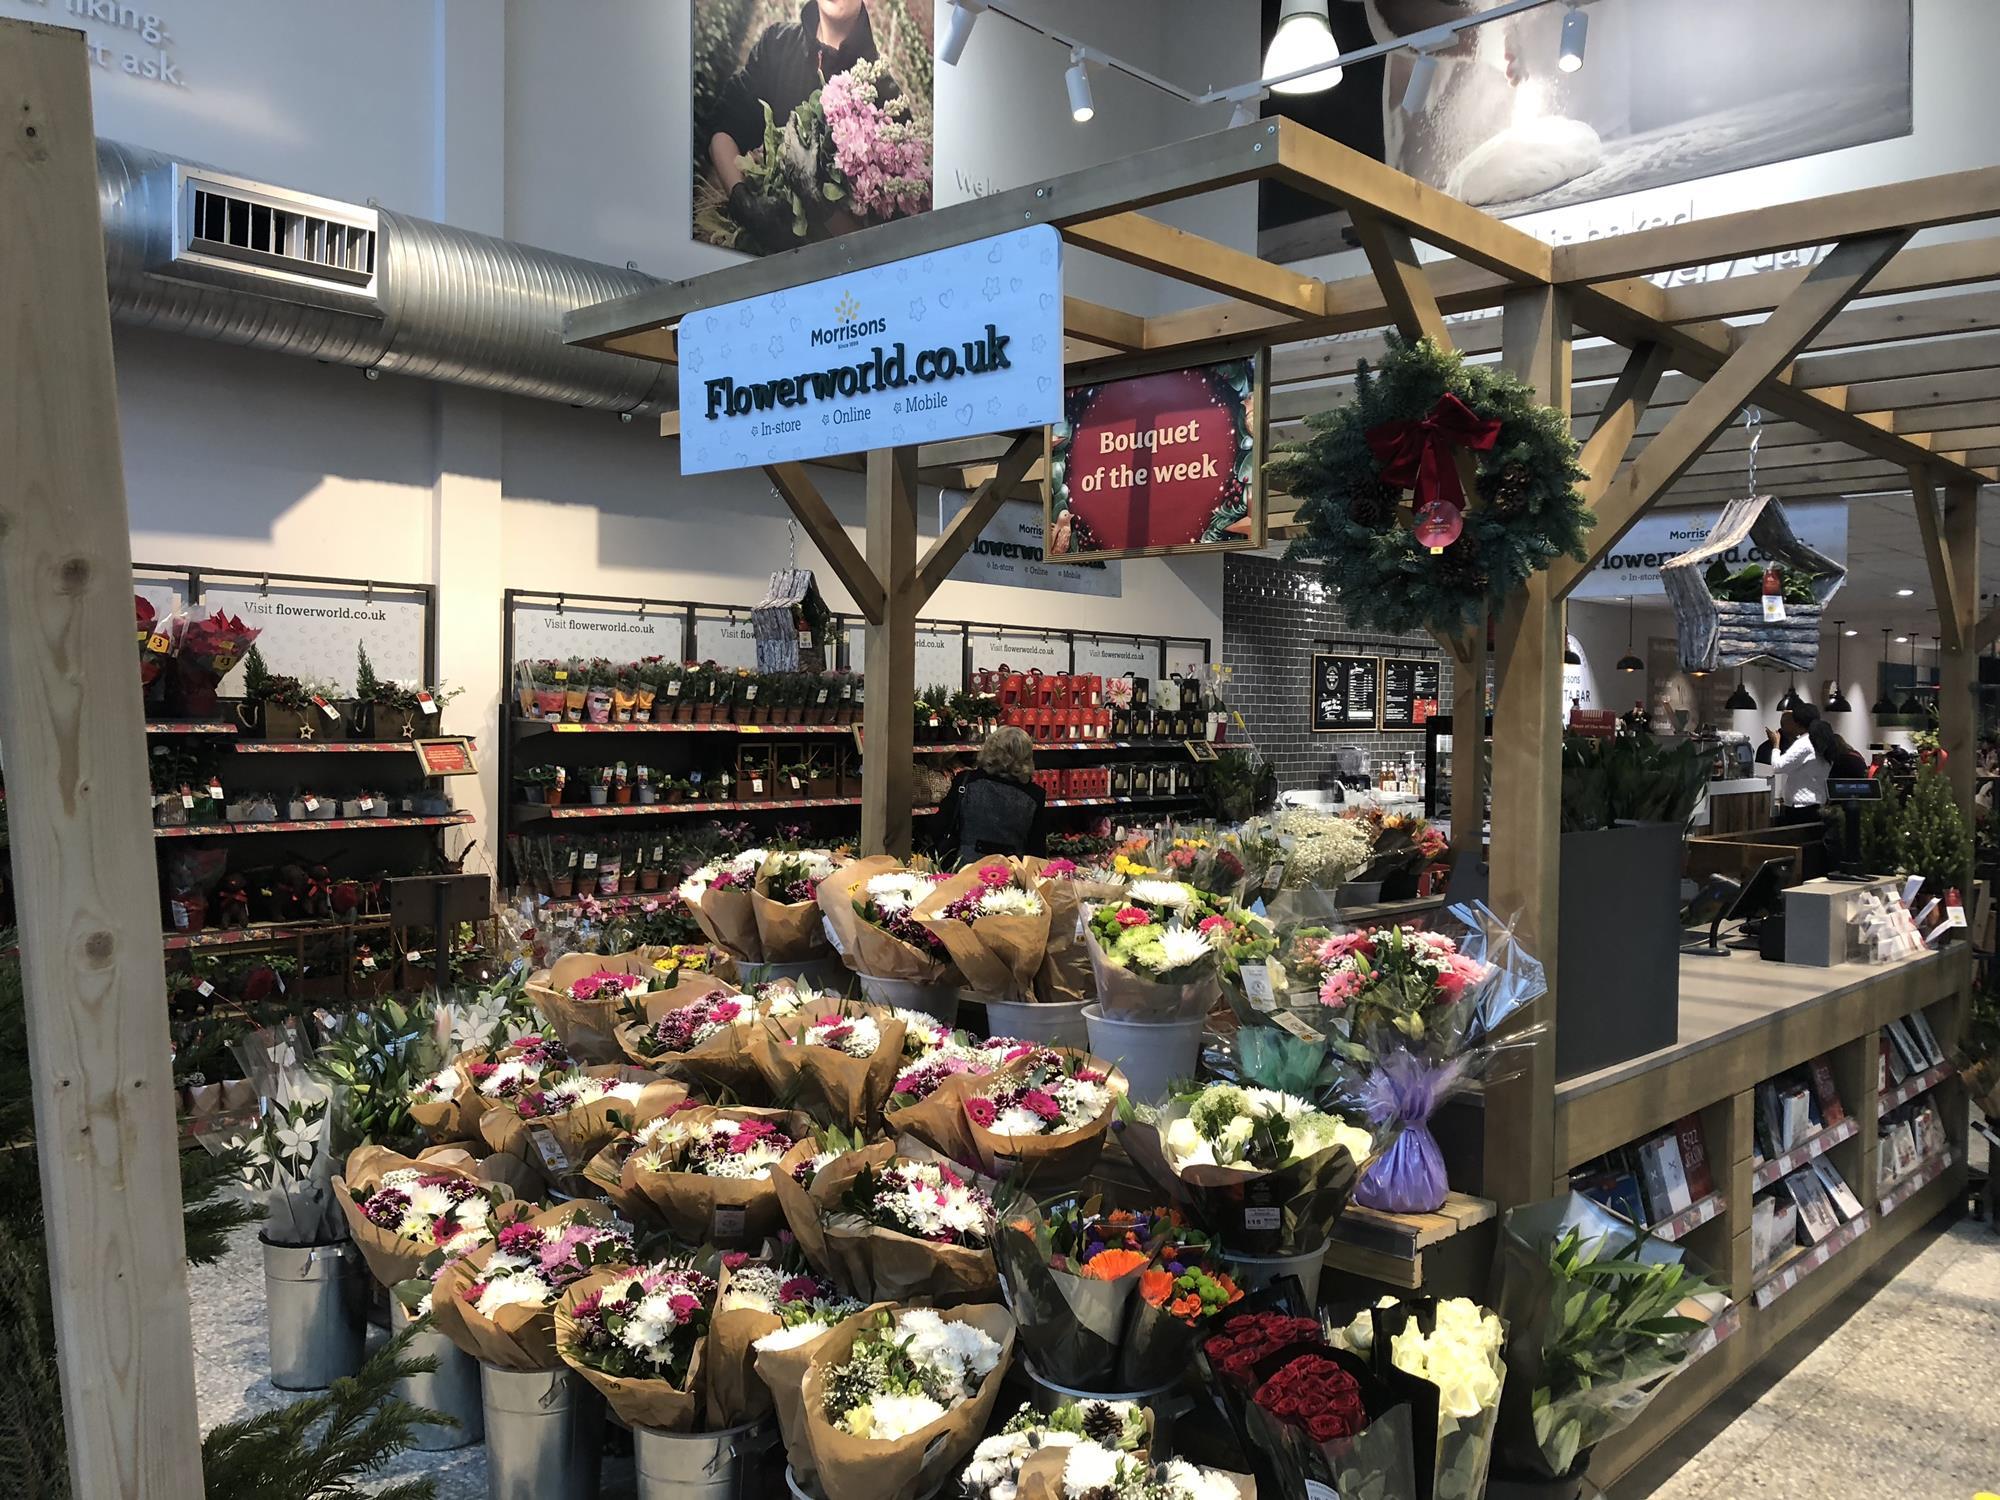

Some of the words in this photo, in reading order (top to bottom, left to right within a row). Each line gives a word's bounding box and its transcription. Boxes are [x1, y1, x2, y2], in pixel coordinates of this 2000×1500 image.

[121, 50, 186, 86] ask.
[811, 317, 887, 347] Morrisons
[704, 324, 1012, 420] Flowerworld.co.uk
[761, 419, 802, 437] In-store
[833, 407, 871, 425] Online
[905, 393, 948, 414] Mobile
[1099, 419, 1201, 454] Bouquet
[1081, 467, 1105, 492] of
[1109, 464, 1148, 490] the
[1153, 453, 1219, 484] week
[1018, 523, 1043, 536] Morris
[1669, 527, 1712, 540] Morriso
[1029, 566, 1049, 576] Online
[244, 601, 273, 615] Visit
[276, 603, 386, 621] flowerworld.co.uk
[544, 618, 567, 629] Visit
[569, 619, 655, 634] flowerworld.co.uk
[720, 628, 739, 639] Visit
[990, 642, 1003, 651] Visit
[1004, 644, 1055, 656] flowerworld.co.uk
[1101, 650, 1145, 660] flowerworld.co.uk
